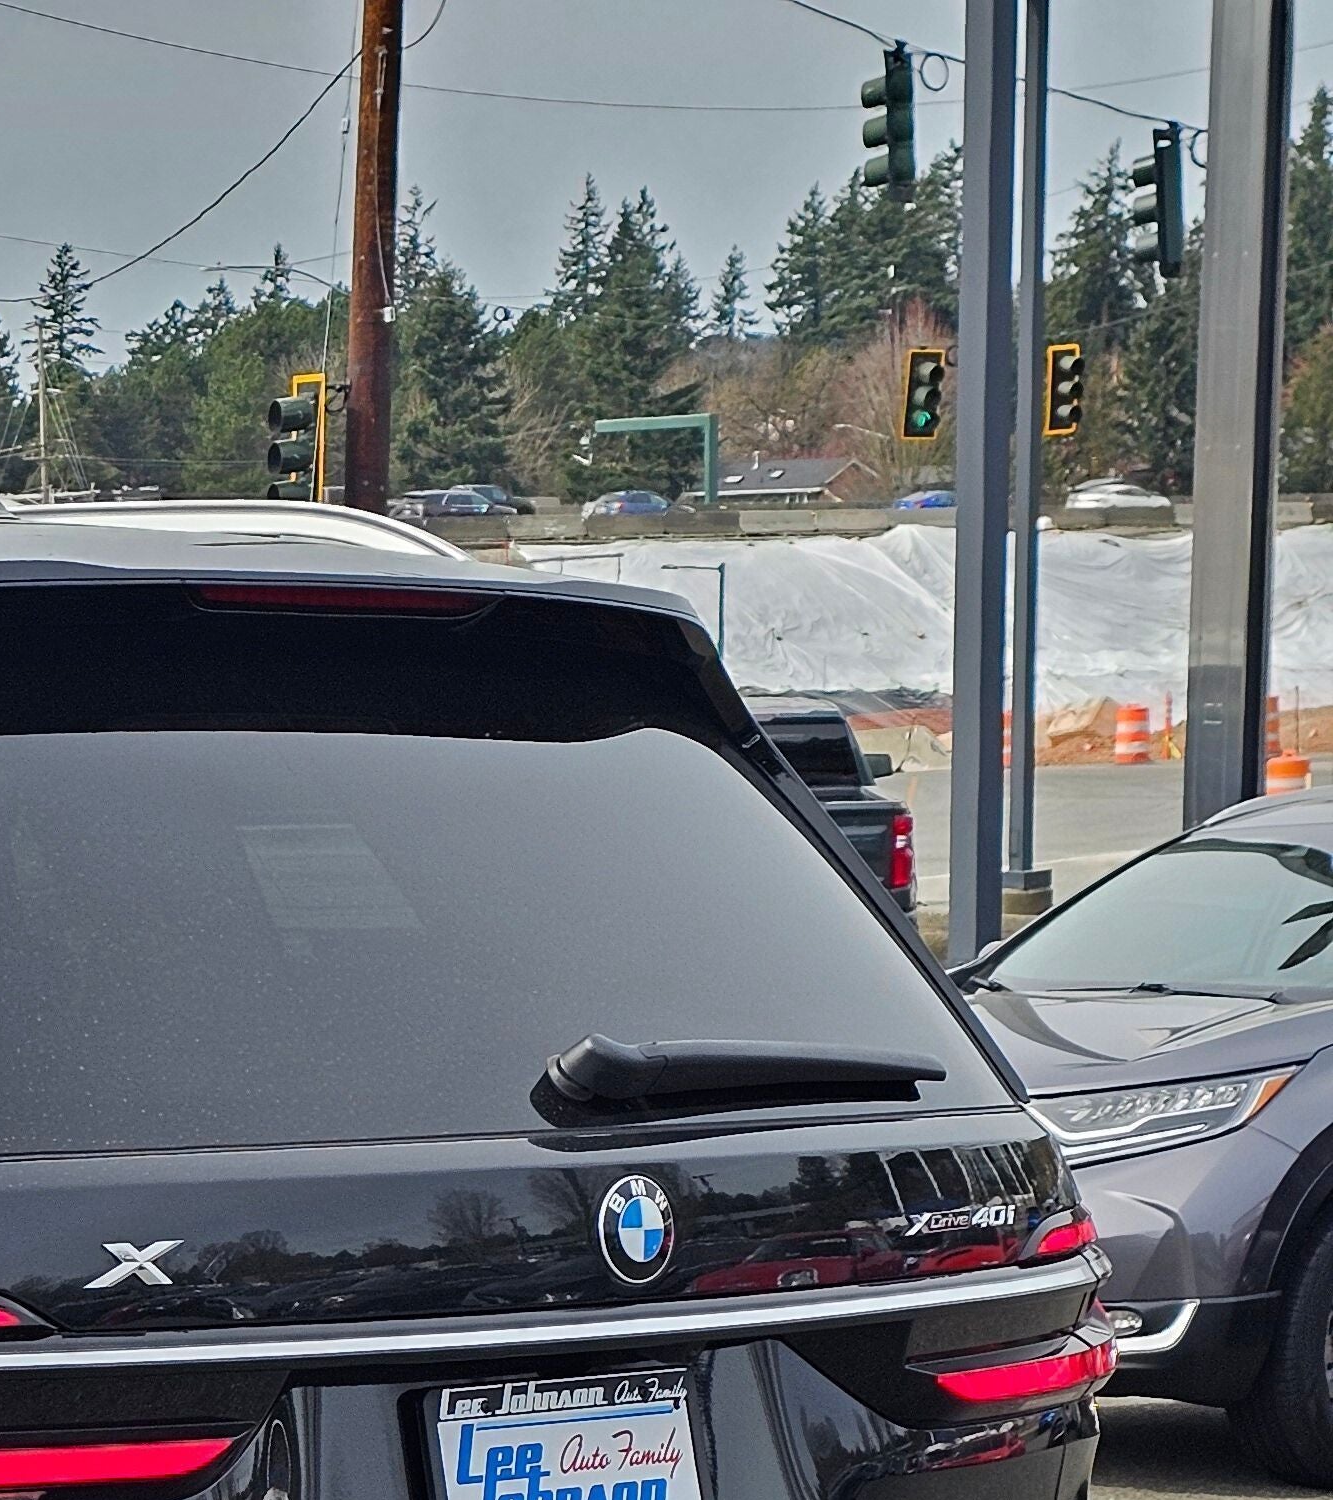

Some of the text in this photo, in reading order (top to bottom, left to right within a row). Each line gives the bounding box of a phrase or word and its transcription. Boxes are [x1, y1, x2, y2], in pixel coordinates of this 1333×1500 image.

[608, 1179, 668, 1214] BMW
[494, 1381, 608, 1415] Johnson
[645, 1376, 688, 1407] Family
[457, 1424, 684, 1485] Lee Auto Family
